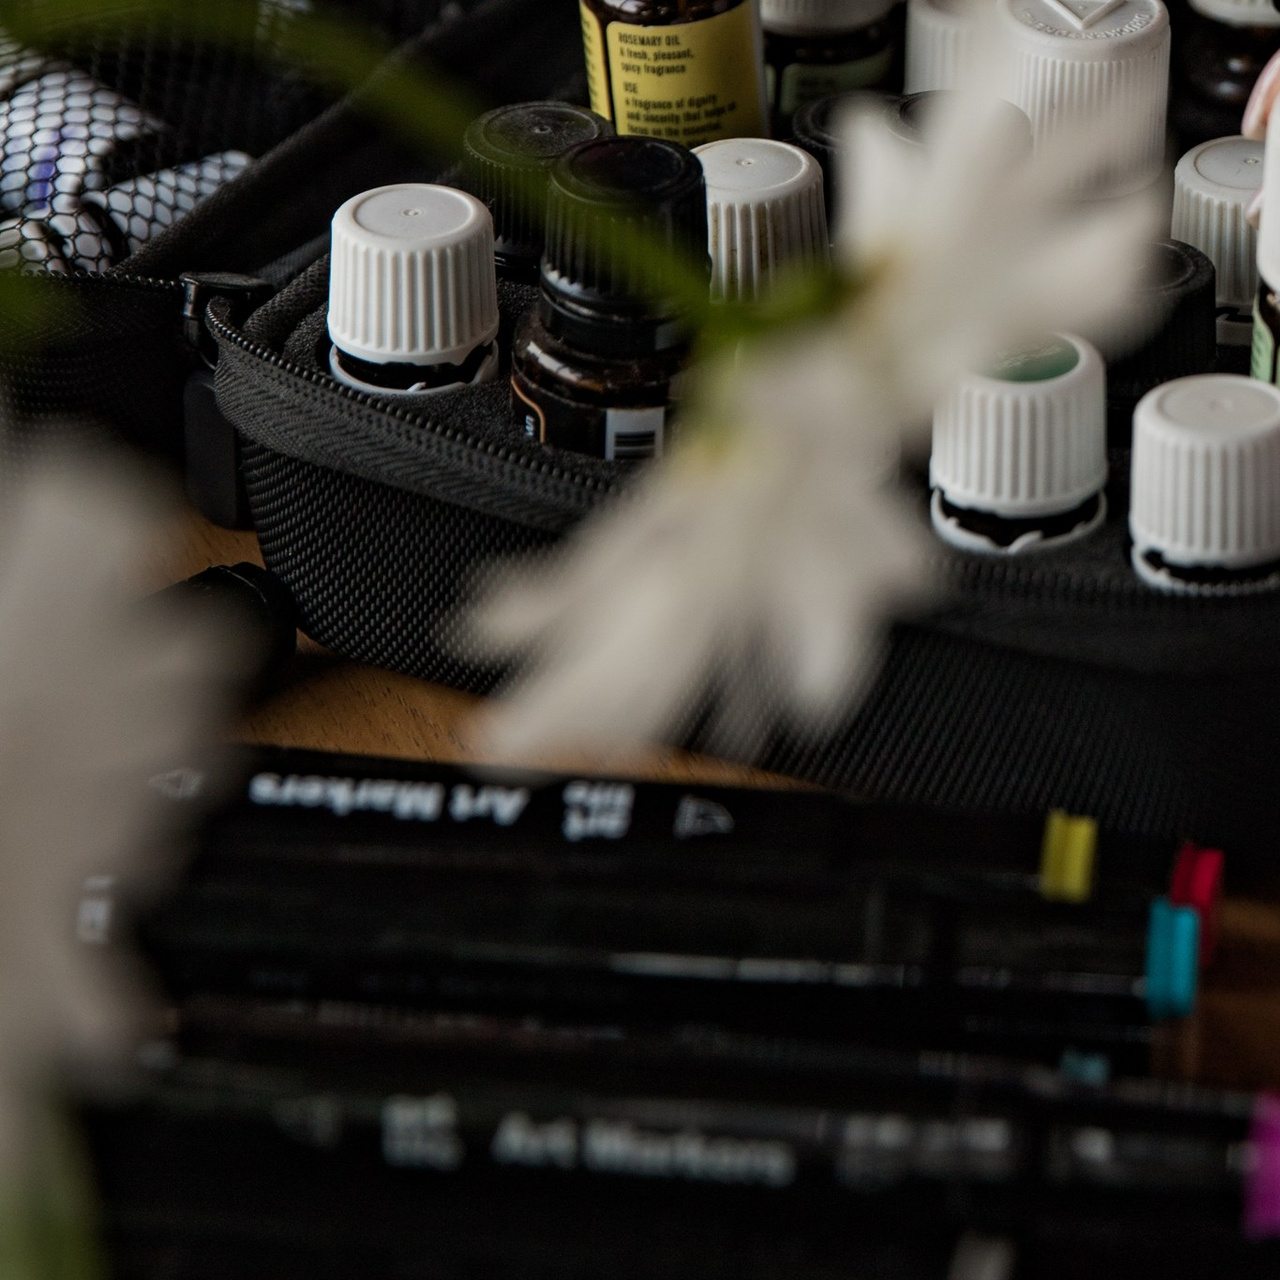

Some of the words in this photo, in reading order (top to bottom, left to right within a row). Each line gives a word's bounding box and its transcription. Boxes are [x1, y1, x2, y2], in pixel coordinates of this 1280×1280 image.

[618, 32, 661, 46] ROSEMARY
[665, 35, 680, 46] OIL
[643, 63, 686, 76] fragrance
[249, 772, 445, 820] Markers
[449, 782, 529, 826] Art
